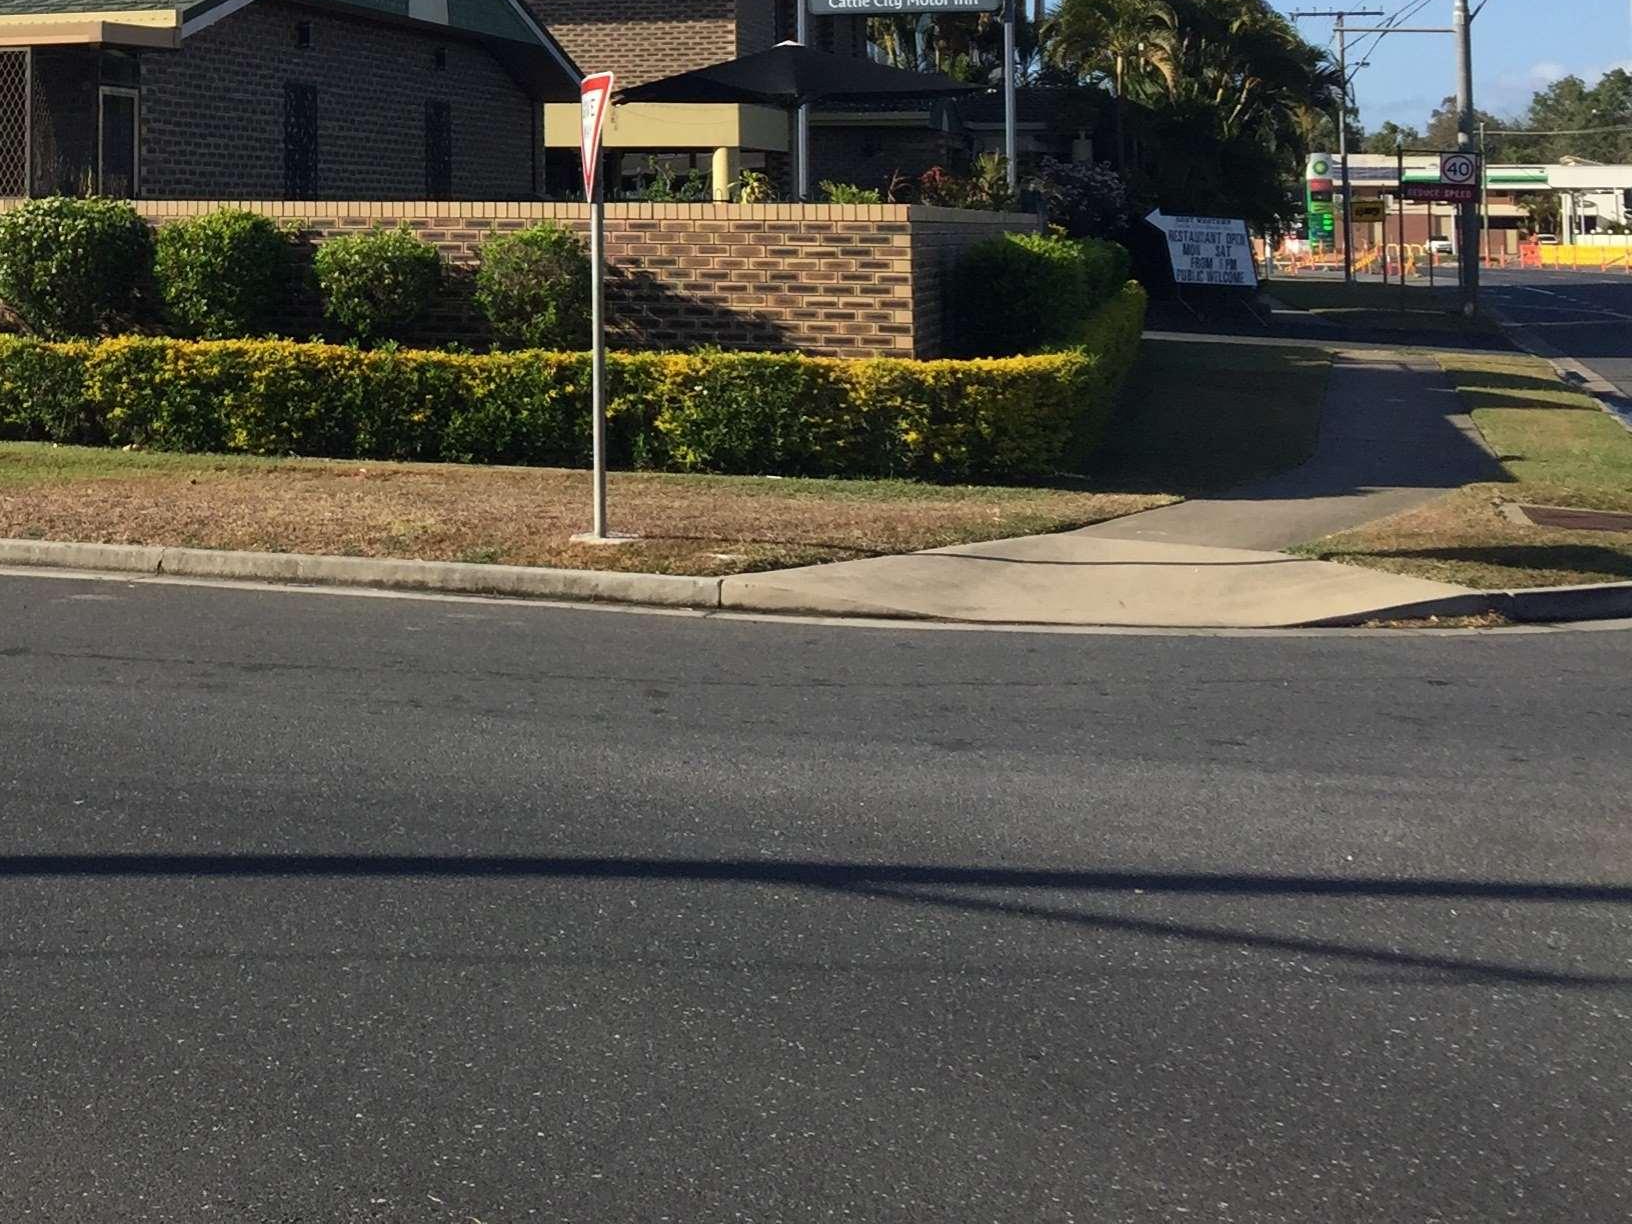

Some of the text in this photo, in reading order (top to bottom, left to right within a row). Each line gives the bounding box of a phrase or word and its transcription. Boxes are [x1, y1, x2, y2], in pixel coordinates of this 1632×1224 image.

[1447, 162, 1470, 176] 40
[1168, 230, 1245, 245] RESTAURANT OPEN
[1215, 245, 1232, 257] SAT
[1190, 257, 1213, 269] FROM
[1225, 258, 1237, 270] PM
[1176, 268, 1245, 283] PUBLIC WELCOME
